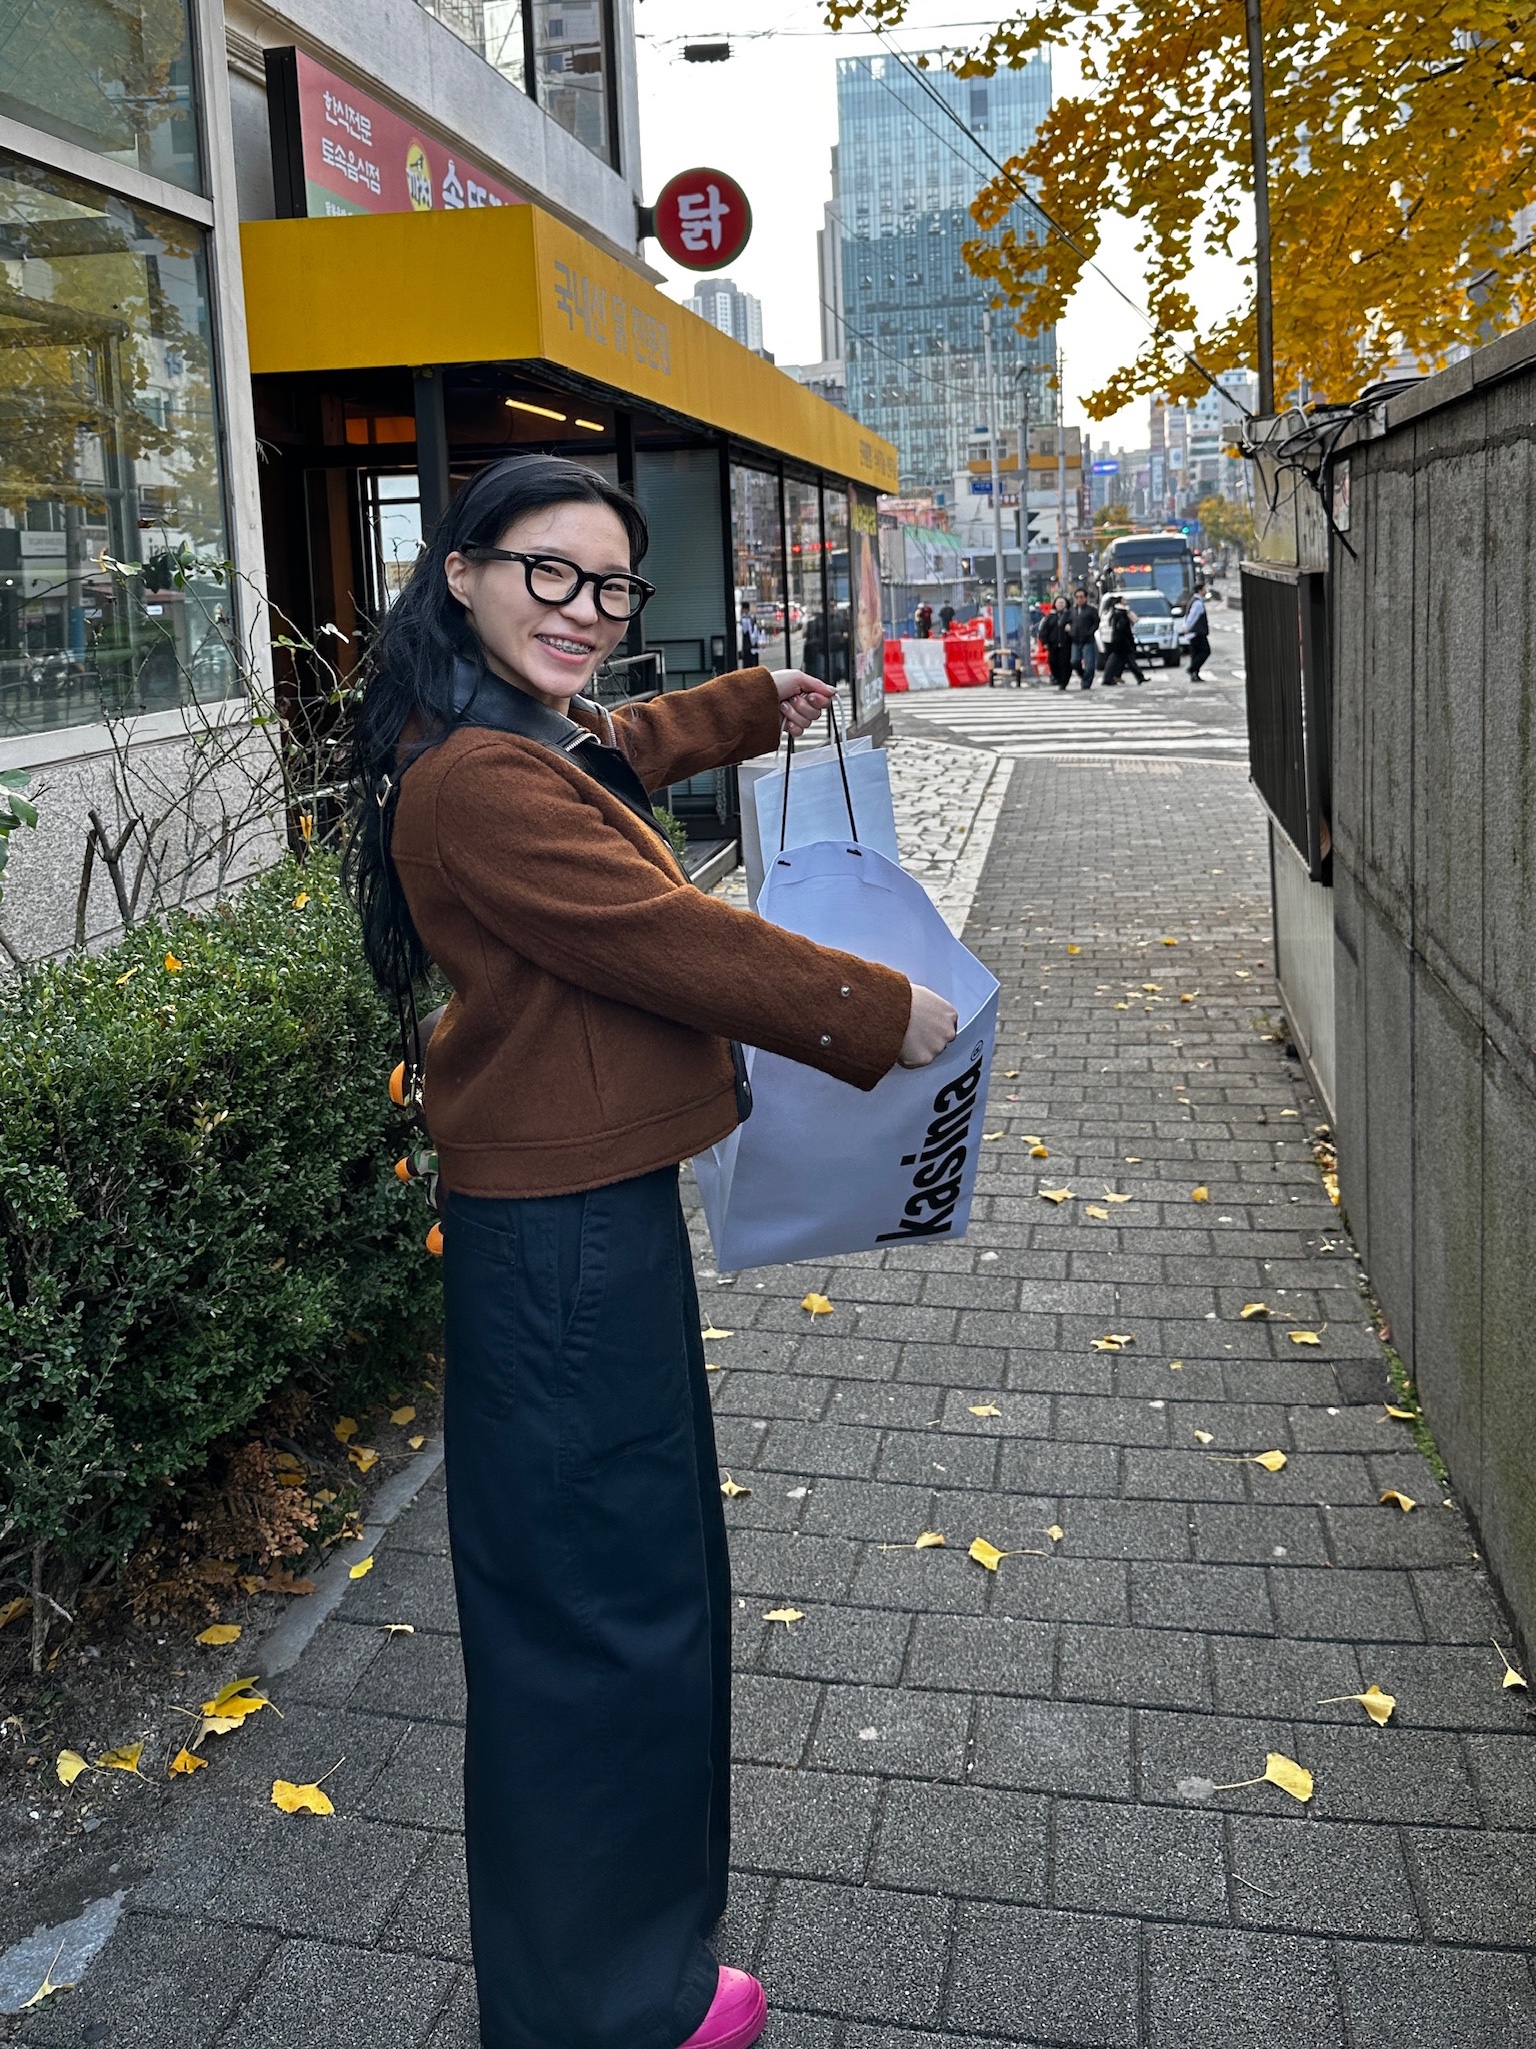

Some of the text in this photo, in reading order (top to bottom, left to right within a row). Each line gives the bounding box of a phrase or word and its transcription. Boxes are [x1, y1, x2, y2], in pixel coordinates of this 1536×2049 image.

[323, 90, 373, 147] 한식전문
[321, 136, 382, 195] 토속음식점
[677, 184, 731, 251] 닭
[554, 260, 672, 376] 국내산 닭 전문점
